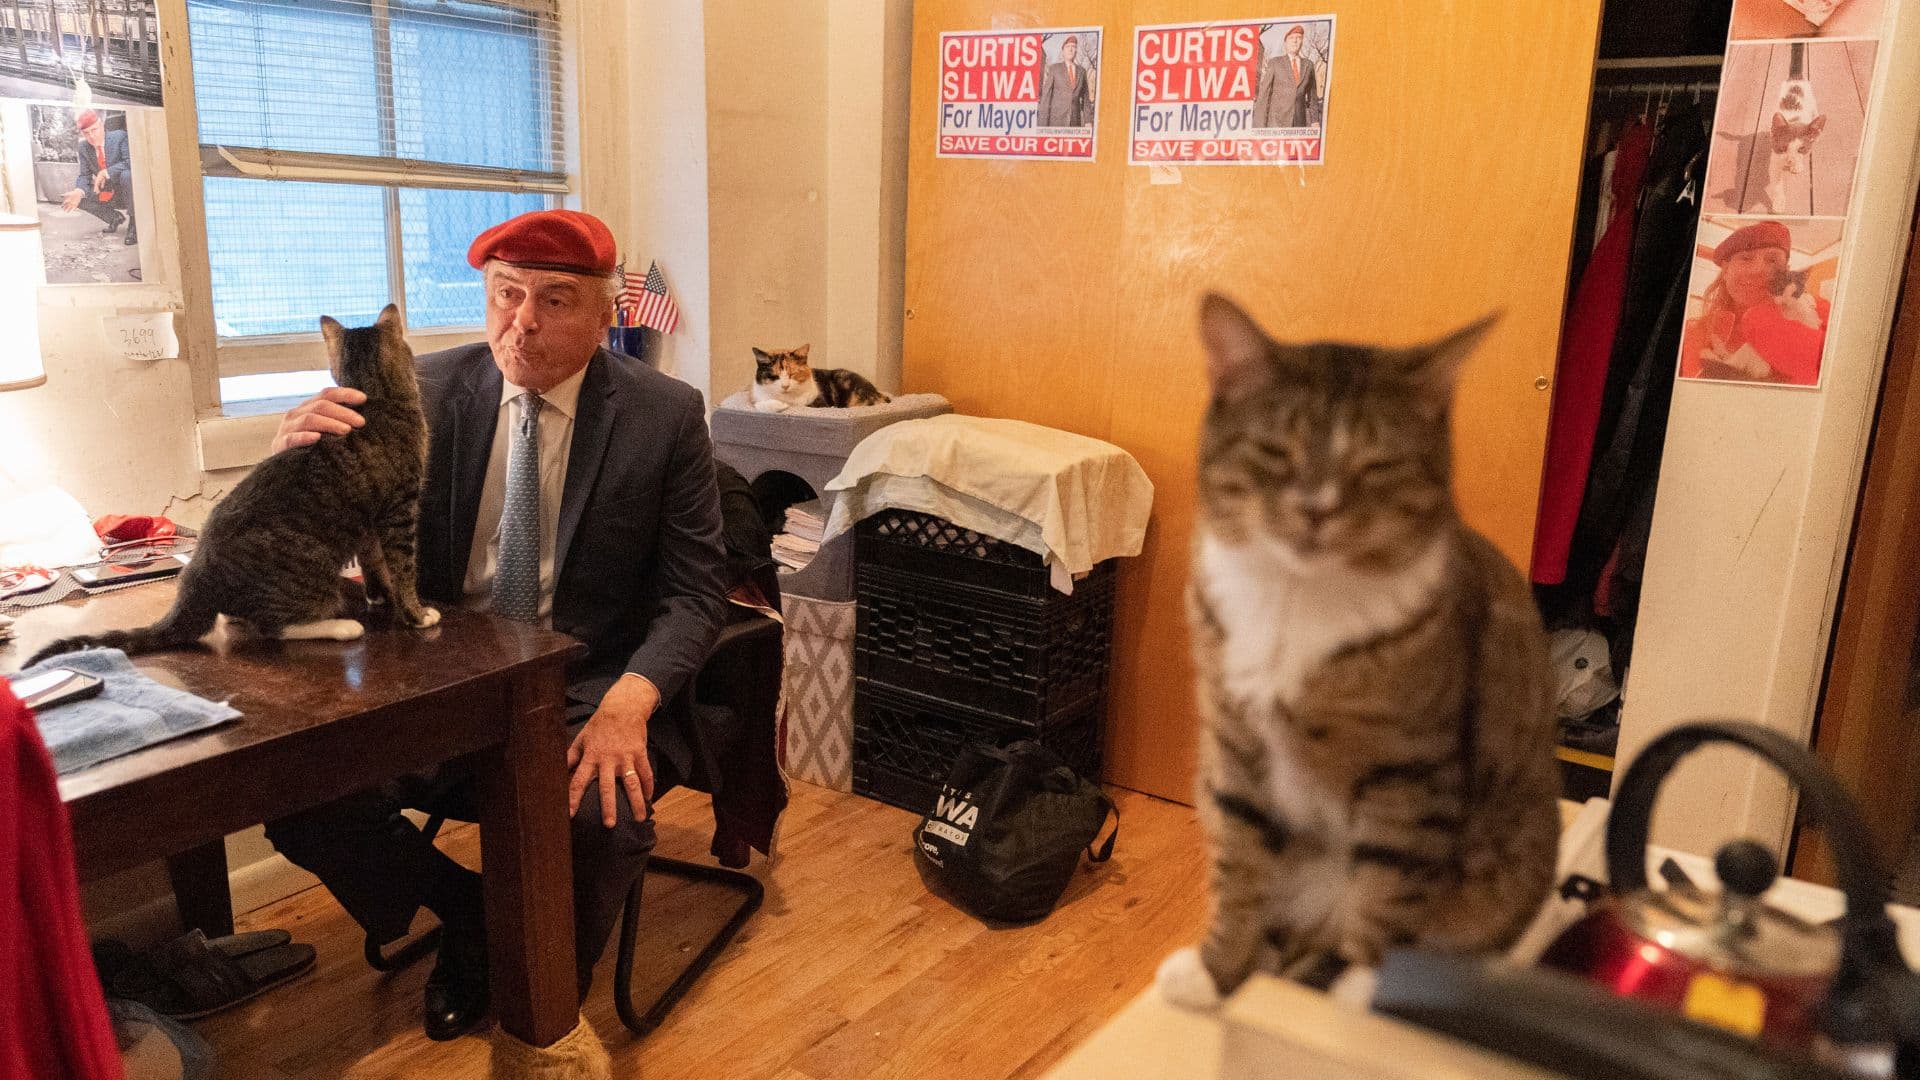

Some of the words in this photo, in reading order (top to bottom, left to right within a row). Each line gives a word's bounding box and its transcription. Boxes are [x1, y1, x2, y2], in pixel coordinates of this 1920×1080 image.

[944, 36, 1038, 68] CURTIS
[1140, 28, 1254, 66] CURTIS
[943, 70, 1036, 100] SLIWA
[1137, 66, 1251, 102] SLIWA
[943, 103, 972, 129] For
[978, 103, 1036, 135] Mayor
[1136, 104, 1173, 133] For
[1180, 103, 1252, 138] Mayor
[941, 136, 990, 151] SAVE
[996, 137, 1038, 152] OUR
[1043, 138, 1091, 153] CITY
[1135, 141, 1194, 157] SAVE
[1202, 140, 1253, 157] OUR
[1260, 140, 1319, 157] CITY
